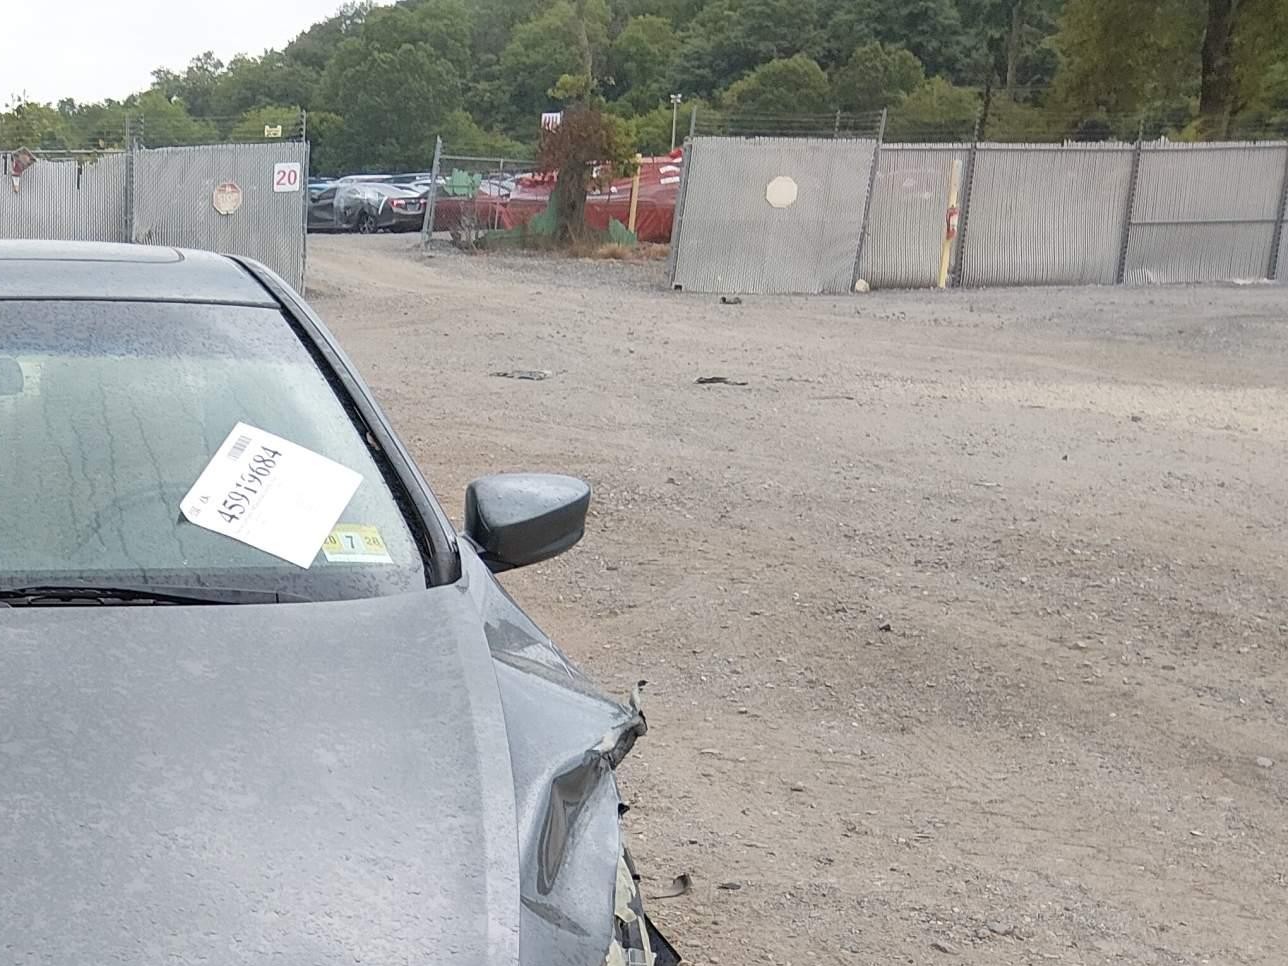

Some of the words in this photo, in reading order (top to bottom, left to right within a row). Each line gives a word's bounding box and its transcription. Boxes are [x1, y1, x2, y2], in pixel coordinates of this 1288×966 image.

[276, 169, 297, 186] 20
[217, 445, 282, 523] 45919684
[344, 535, 355, 549] 7
